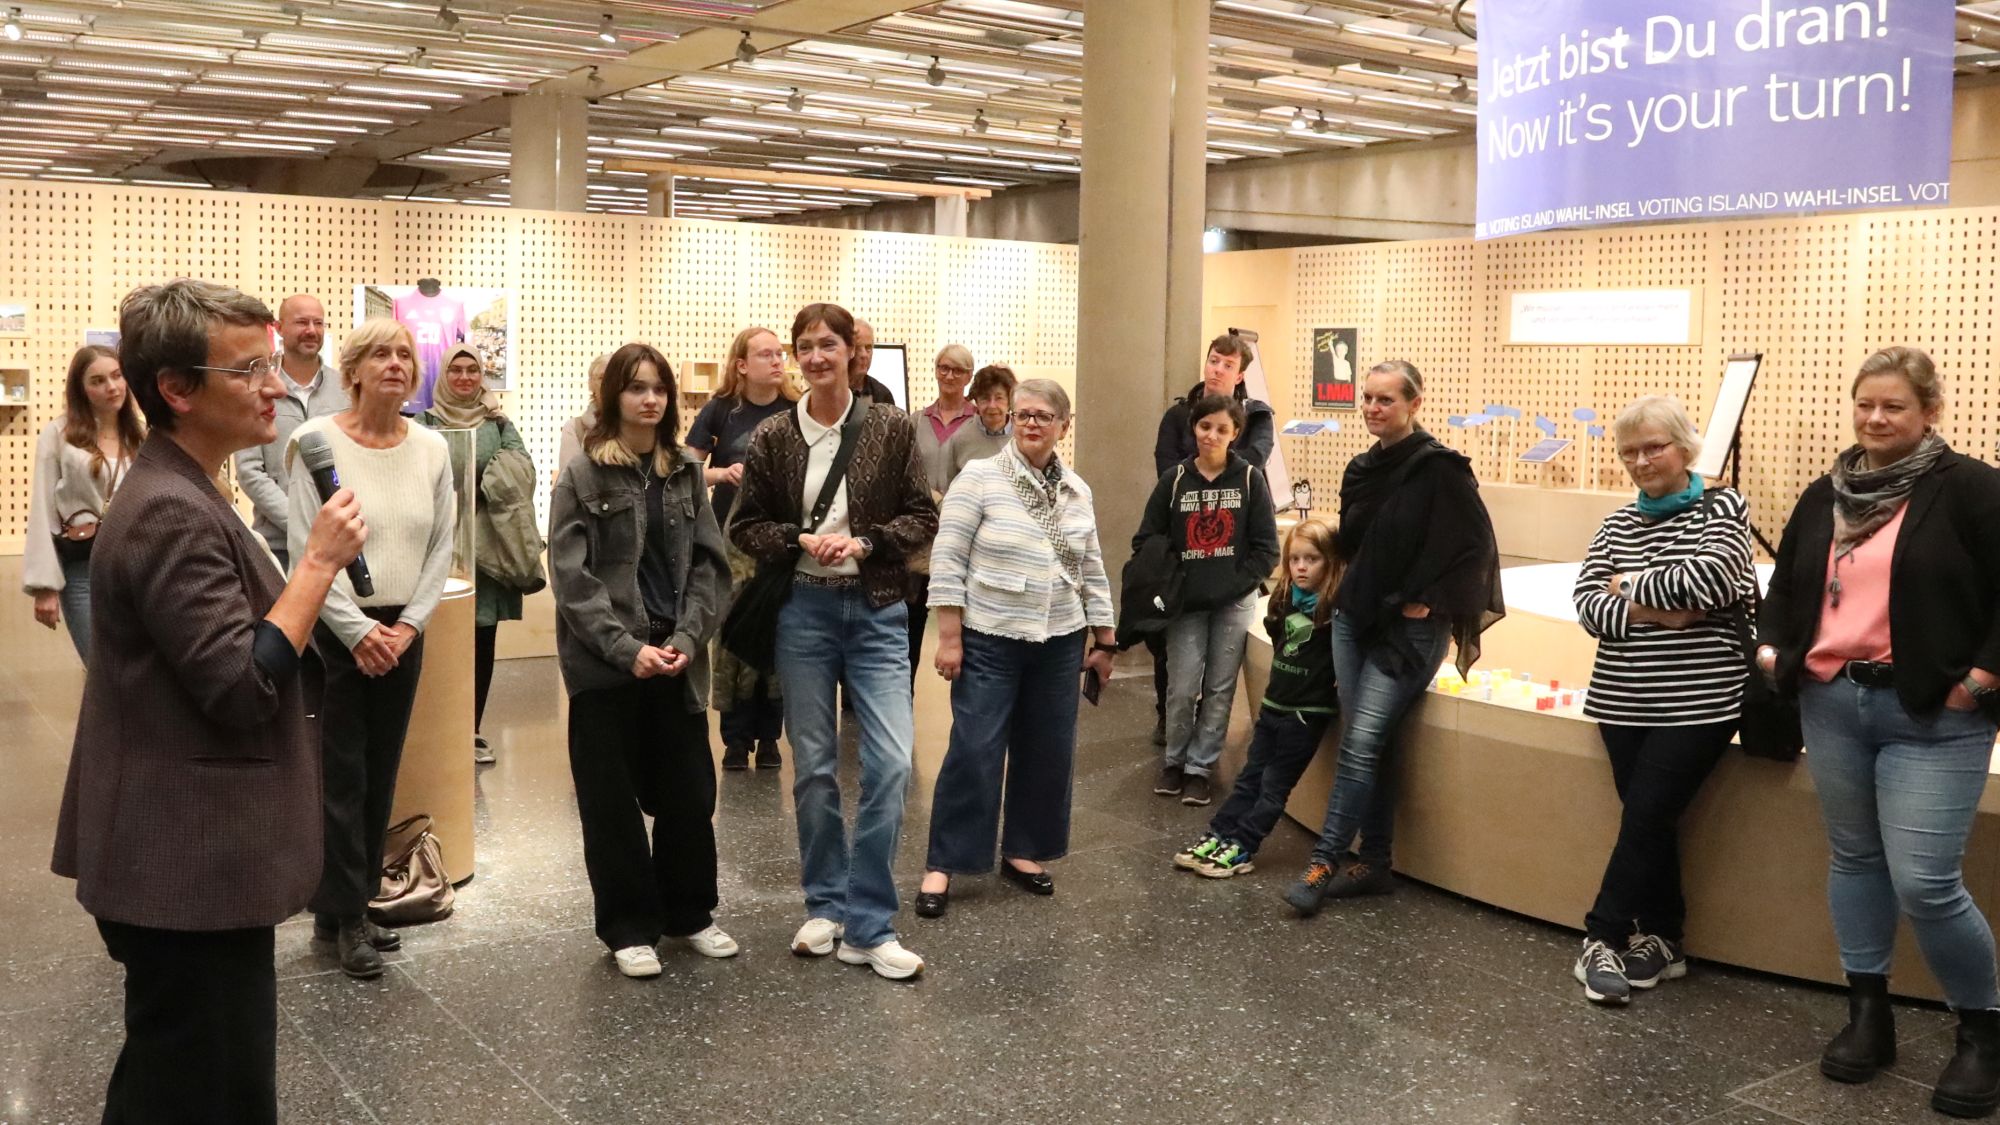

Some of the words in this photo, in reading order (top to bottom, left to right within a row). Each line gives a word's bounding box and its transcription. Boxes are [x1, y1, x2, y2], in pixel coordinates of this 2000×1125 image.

[1488, 45, 1551, 103] Jetzt
[1559, 26, 1629, 80] bist
[1645, 15, 1715, 65] Du
[1734, 0, 1887, 51] dran!
[1489, 115, 1550, 163] Now
[1627, 86, 1748, 148] your
[1764, 57, 1911, 122] turn!
[1489, 215, 1520, 235] VOTING
[1521, 209, 1554, 229] ISLAND
[1556, 201, 1634, 224] WAHL-INSEL
[1638, 196, 1703, 216] VOTING
[1708, 192, 1779, 212] ISLAND
[1784, 185, 1903, 207] WAHL-INSEL
[1908, 182, 1951, 201] VOT
[1181, 502, 1202, 512] NAVA
